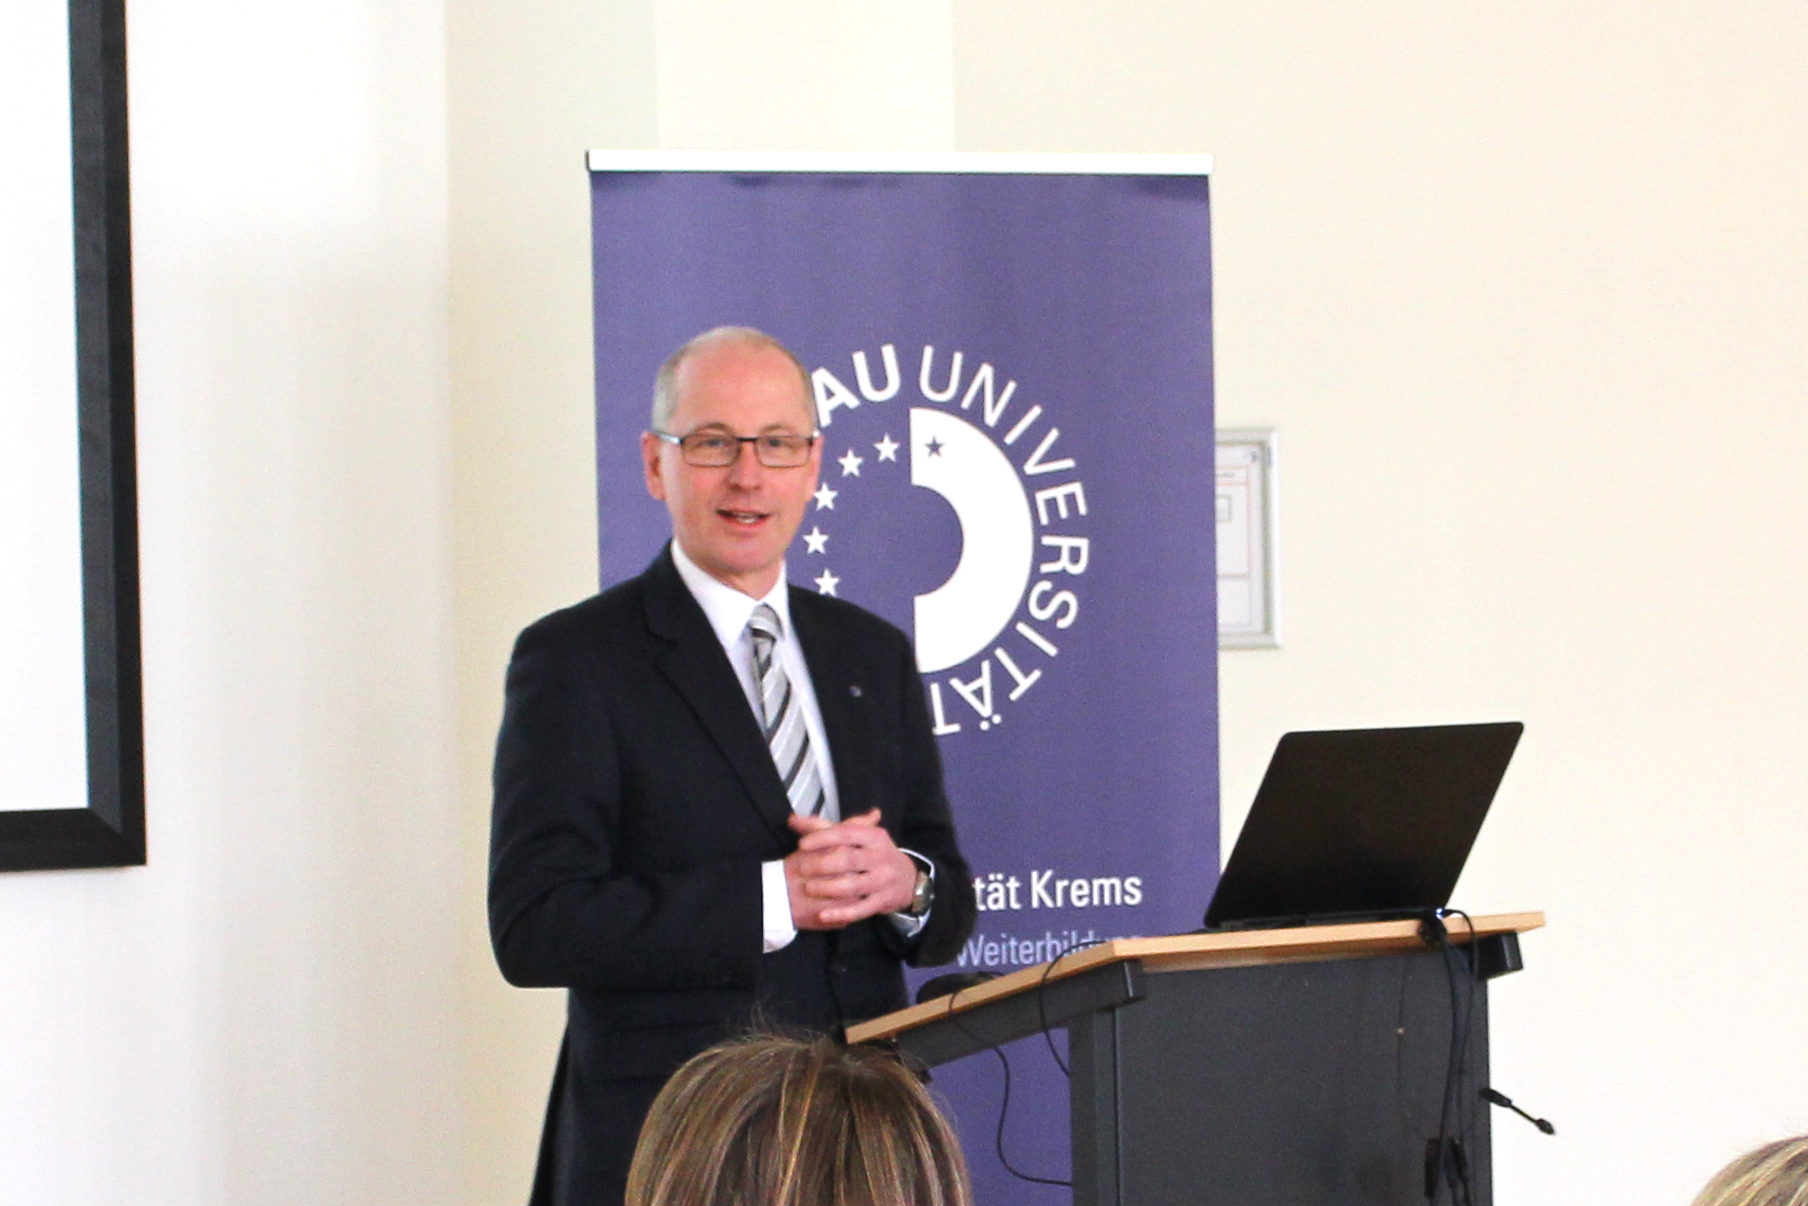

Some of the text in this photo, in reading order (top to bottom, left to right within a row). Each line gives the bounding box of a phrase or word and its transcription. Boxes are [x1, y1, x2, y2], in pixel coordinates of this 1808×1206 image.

[918, 345, 1090, 736] UNIVERSITÄT
[1030, 869, 1144, 909] Krems
[956, 930, 1142, 967] Weiterbild
